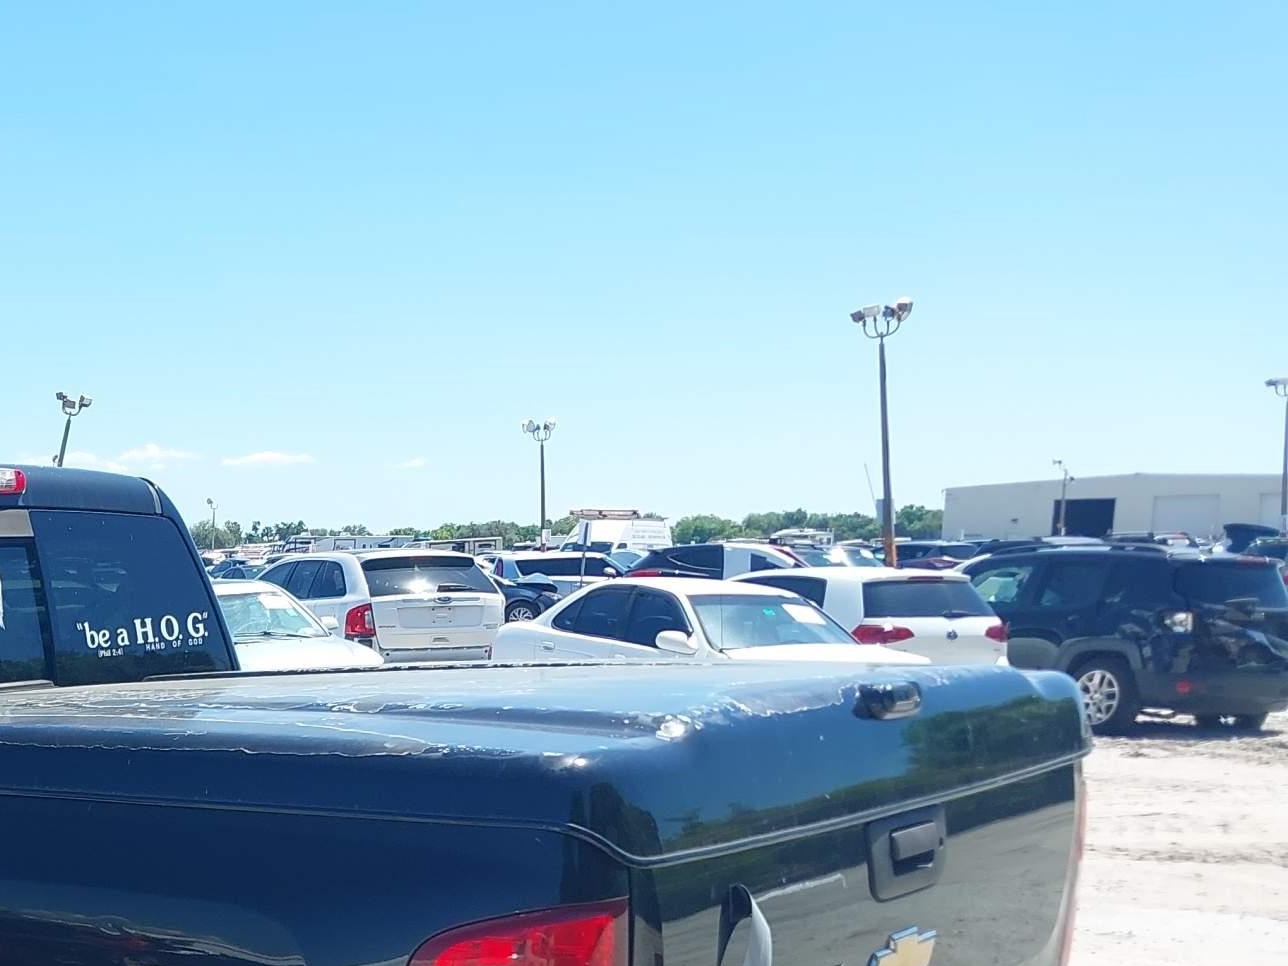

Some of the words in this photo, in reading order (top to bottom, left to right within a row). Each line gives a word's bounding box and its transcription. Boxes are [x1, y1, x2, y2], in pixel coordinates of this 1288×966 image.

[116, 627, 130, 646] a
[145, 642, 166, 652] HAND
[172, 639, 182, 648] OF
[188, 638, 204, 646] GOD
